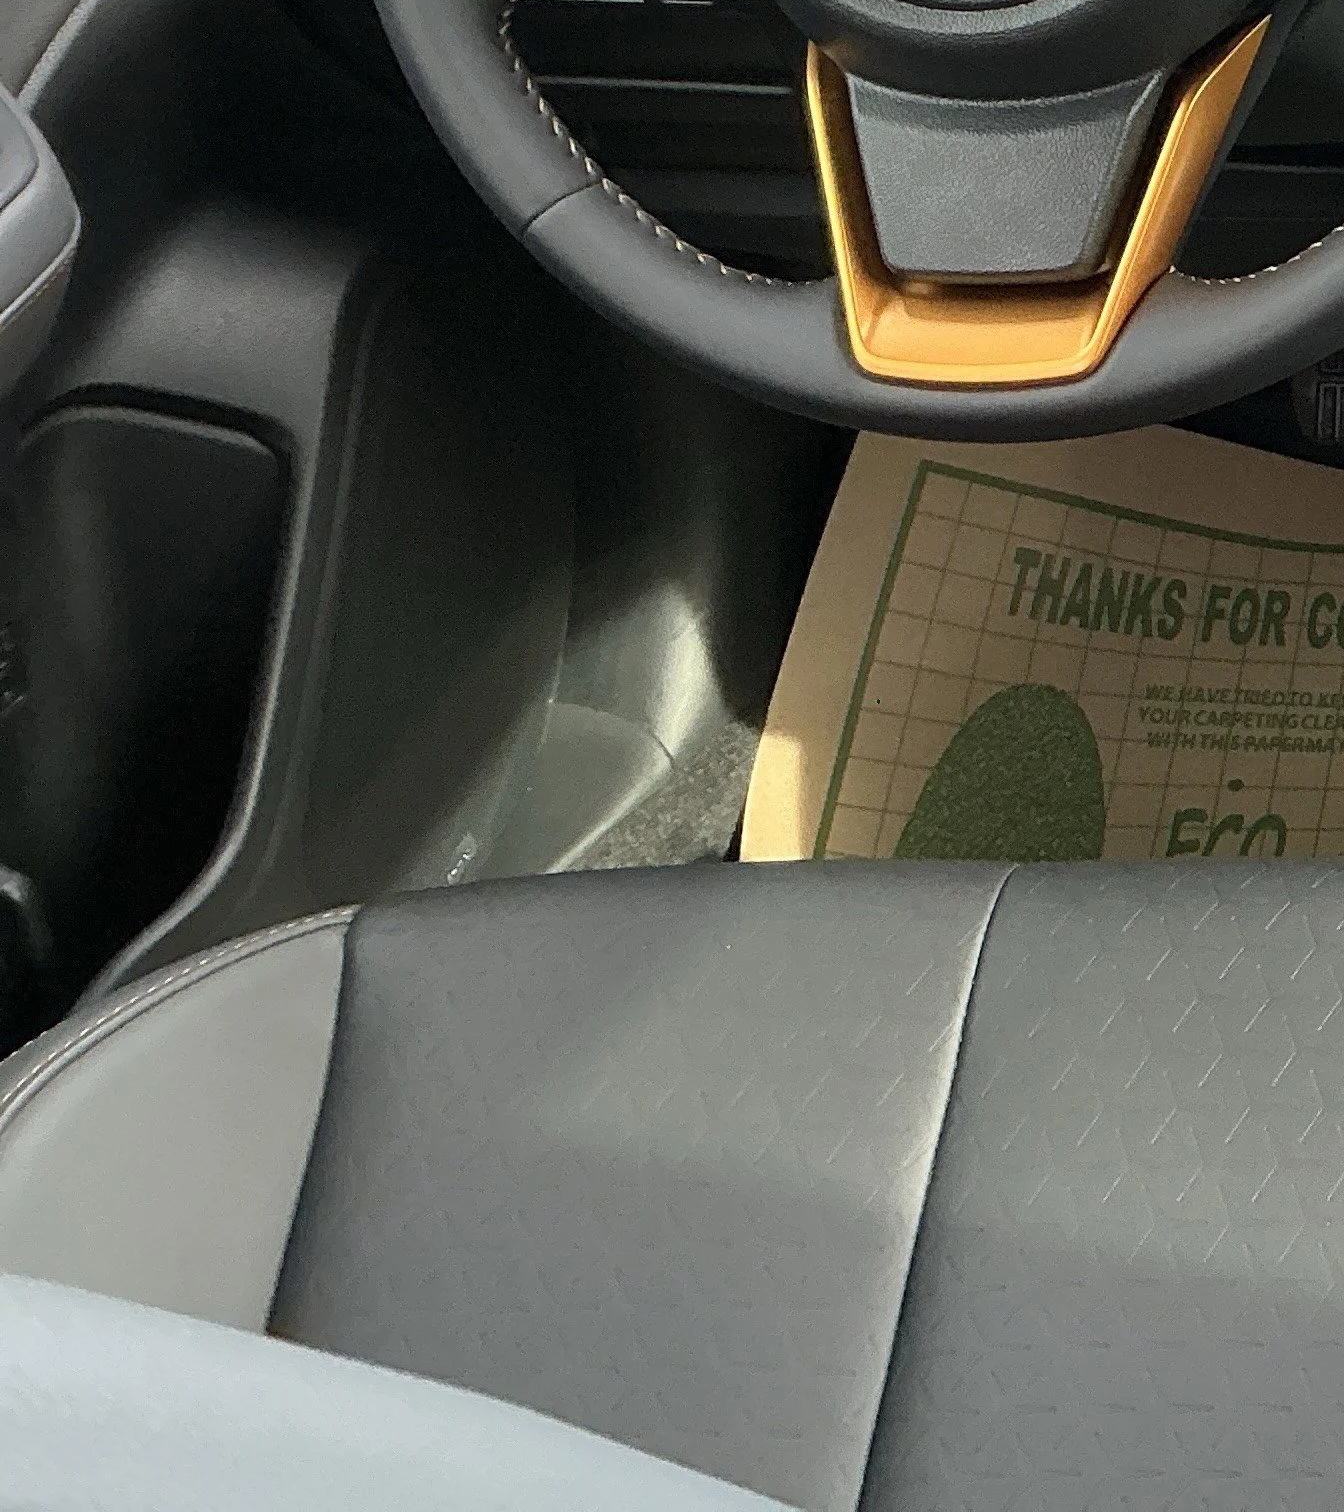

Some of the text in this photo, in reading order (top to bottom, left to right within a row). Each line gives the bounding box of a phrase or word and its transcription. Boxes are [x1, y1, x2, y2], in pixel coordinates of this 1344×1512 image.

[1008, 546, 1187, 644] THANKS
[1201, 584, 1293, 647] FOR
[1138, 707, 1191, 726] YOUR
